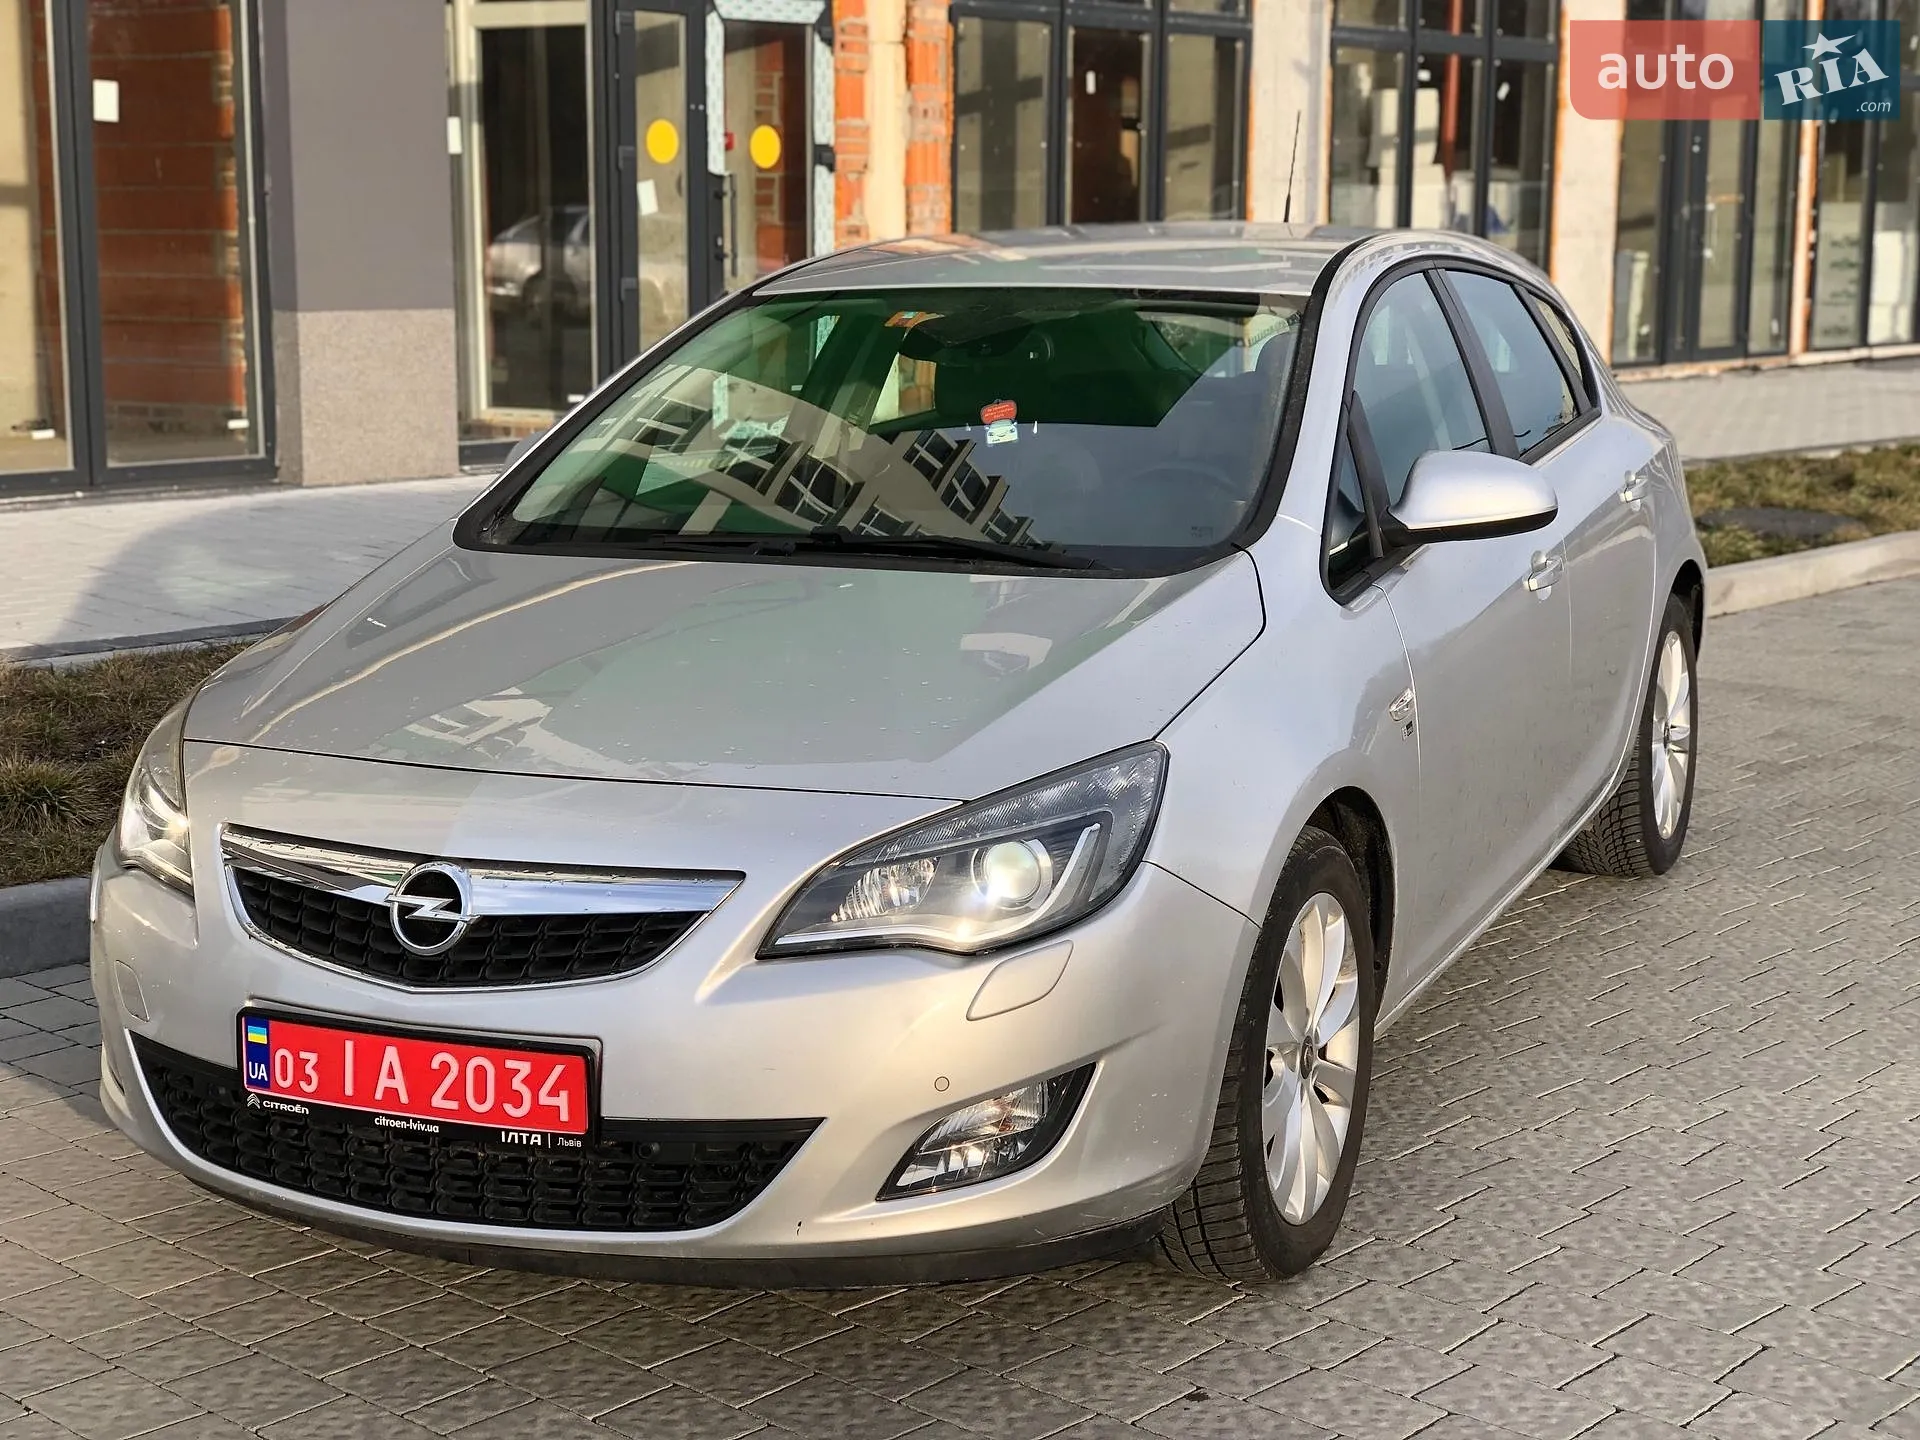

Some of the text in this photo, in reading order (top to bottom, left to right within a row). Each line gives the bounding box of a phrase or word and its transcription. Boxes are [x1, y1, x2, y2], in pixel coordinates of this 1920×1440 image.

[249, 1062, 268, 1081] UA
[272, 1048, 319, 1093] 03
[430, 1052, 569, 1122] 2034
[374, 1116, 439, 1133] citroen-lviv.ua
